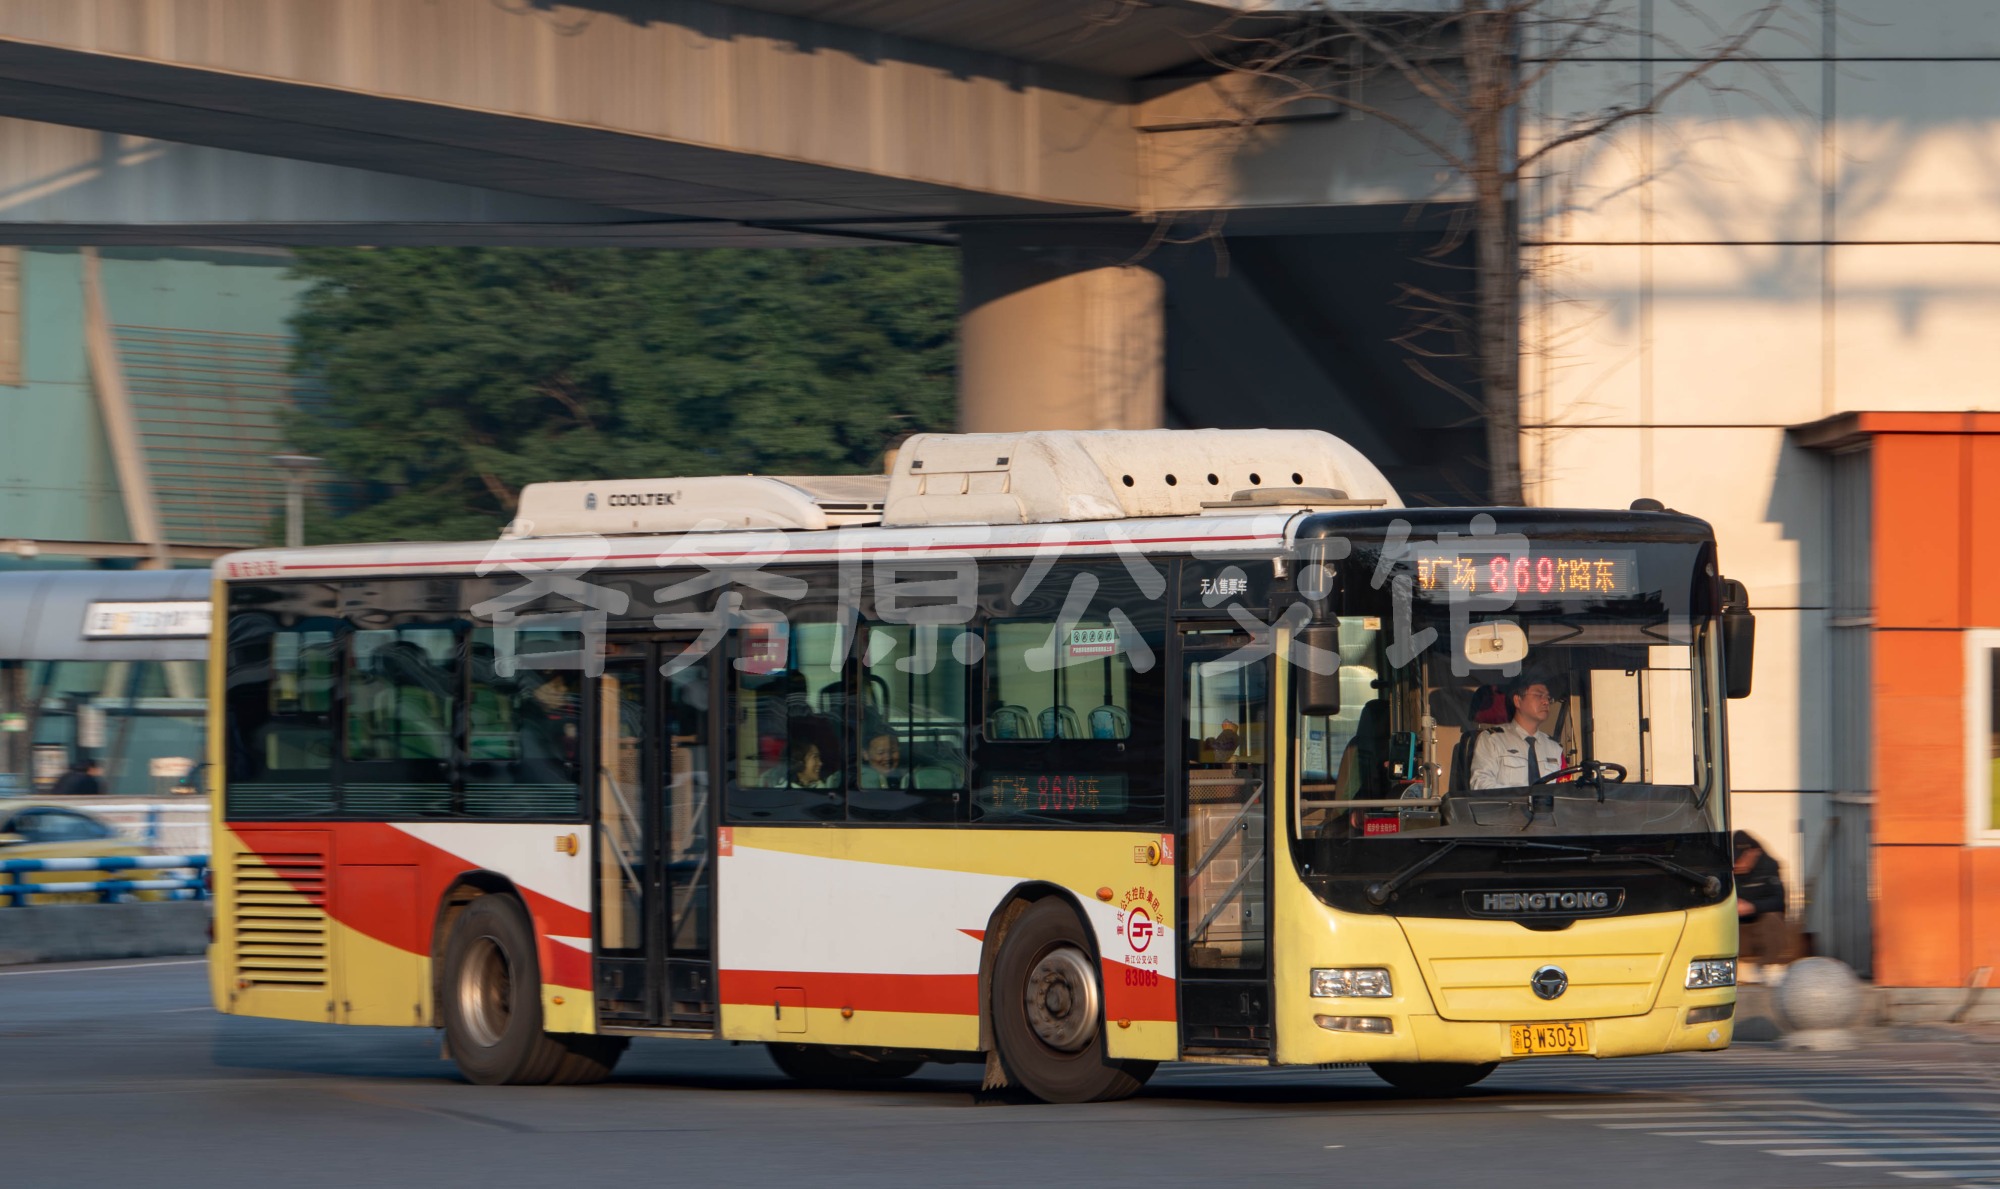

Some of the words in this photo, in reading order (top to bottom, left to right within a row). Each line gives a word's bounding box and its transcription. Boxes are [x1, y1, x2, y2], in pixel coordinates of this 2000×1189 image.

[608, 493, 675, 507] COOLTEK
[1489, 556, 1553, 593] 869
[1200, 578, 1247, 595] 无人售票车
[1038, 775, 1077, 810] 869
[1483, 892, 1608, 910] HENGTONG
[1125, 970, 1158, 987] 83085
